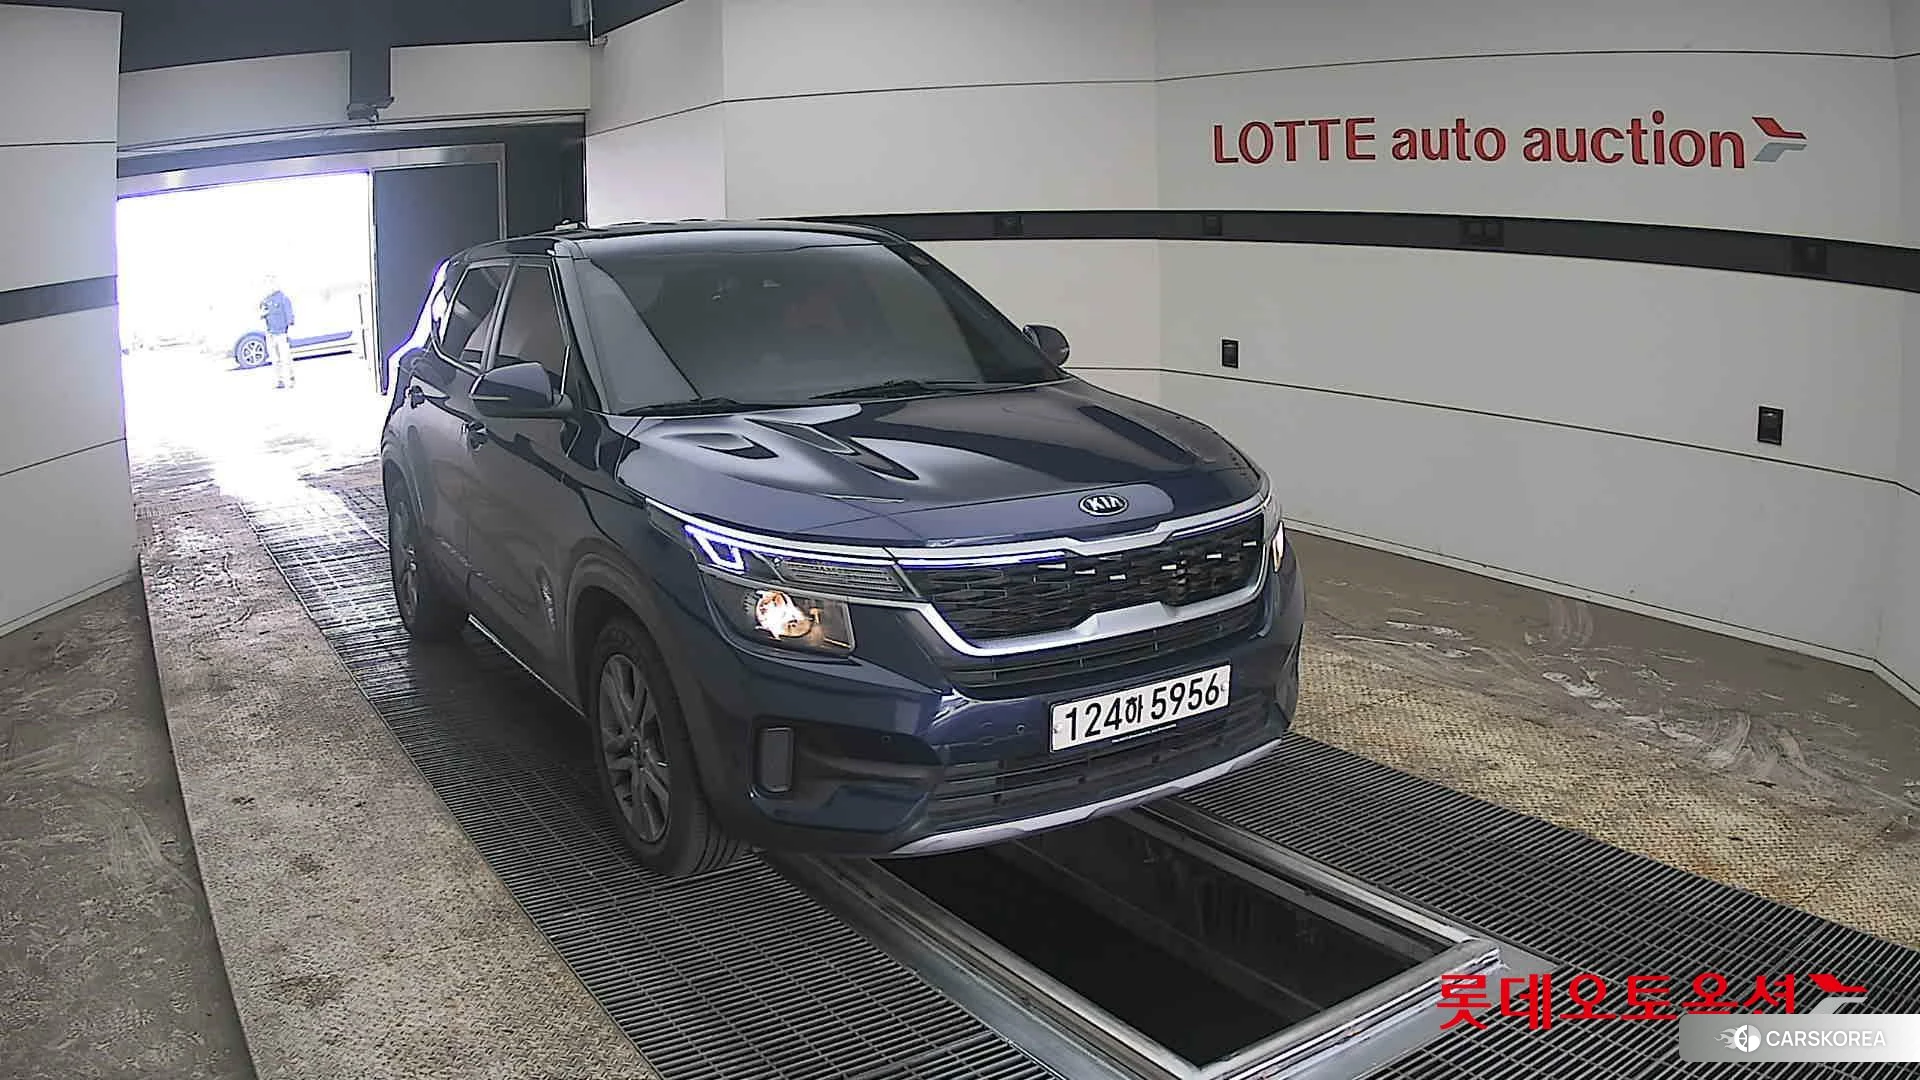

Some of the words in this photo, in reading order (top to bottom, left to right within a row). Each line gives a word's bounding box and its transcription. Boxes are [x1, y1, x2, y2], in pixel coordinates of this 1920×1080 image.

[1211, 116, 1377, 165] LOTTE
[1391, 118, 1507, 162] auto
[1522, 110, 1746, 169] auction
[1086, 496, 1123, 511] KIA
[1065, 694, 1144, 741] 124하
[1150, 672, 1220, 721] 5956
